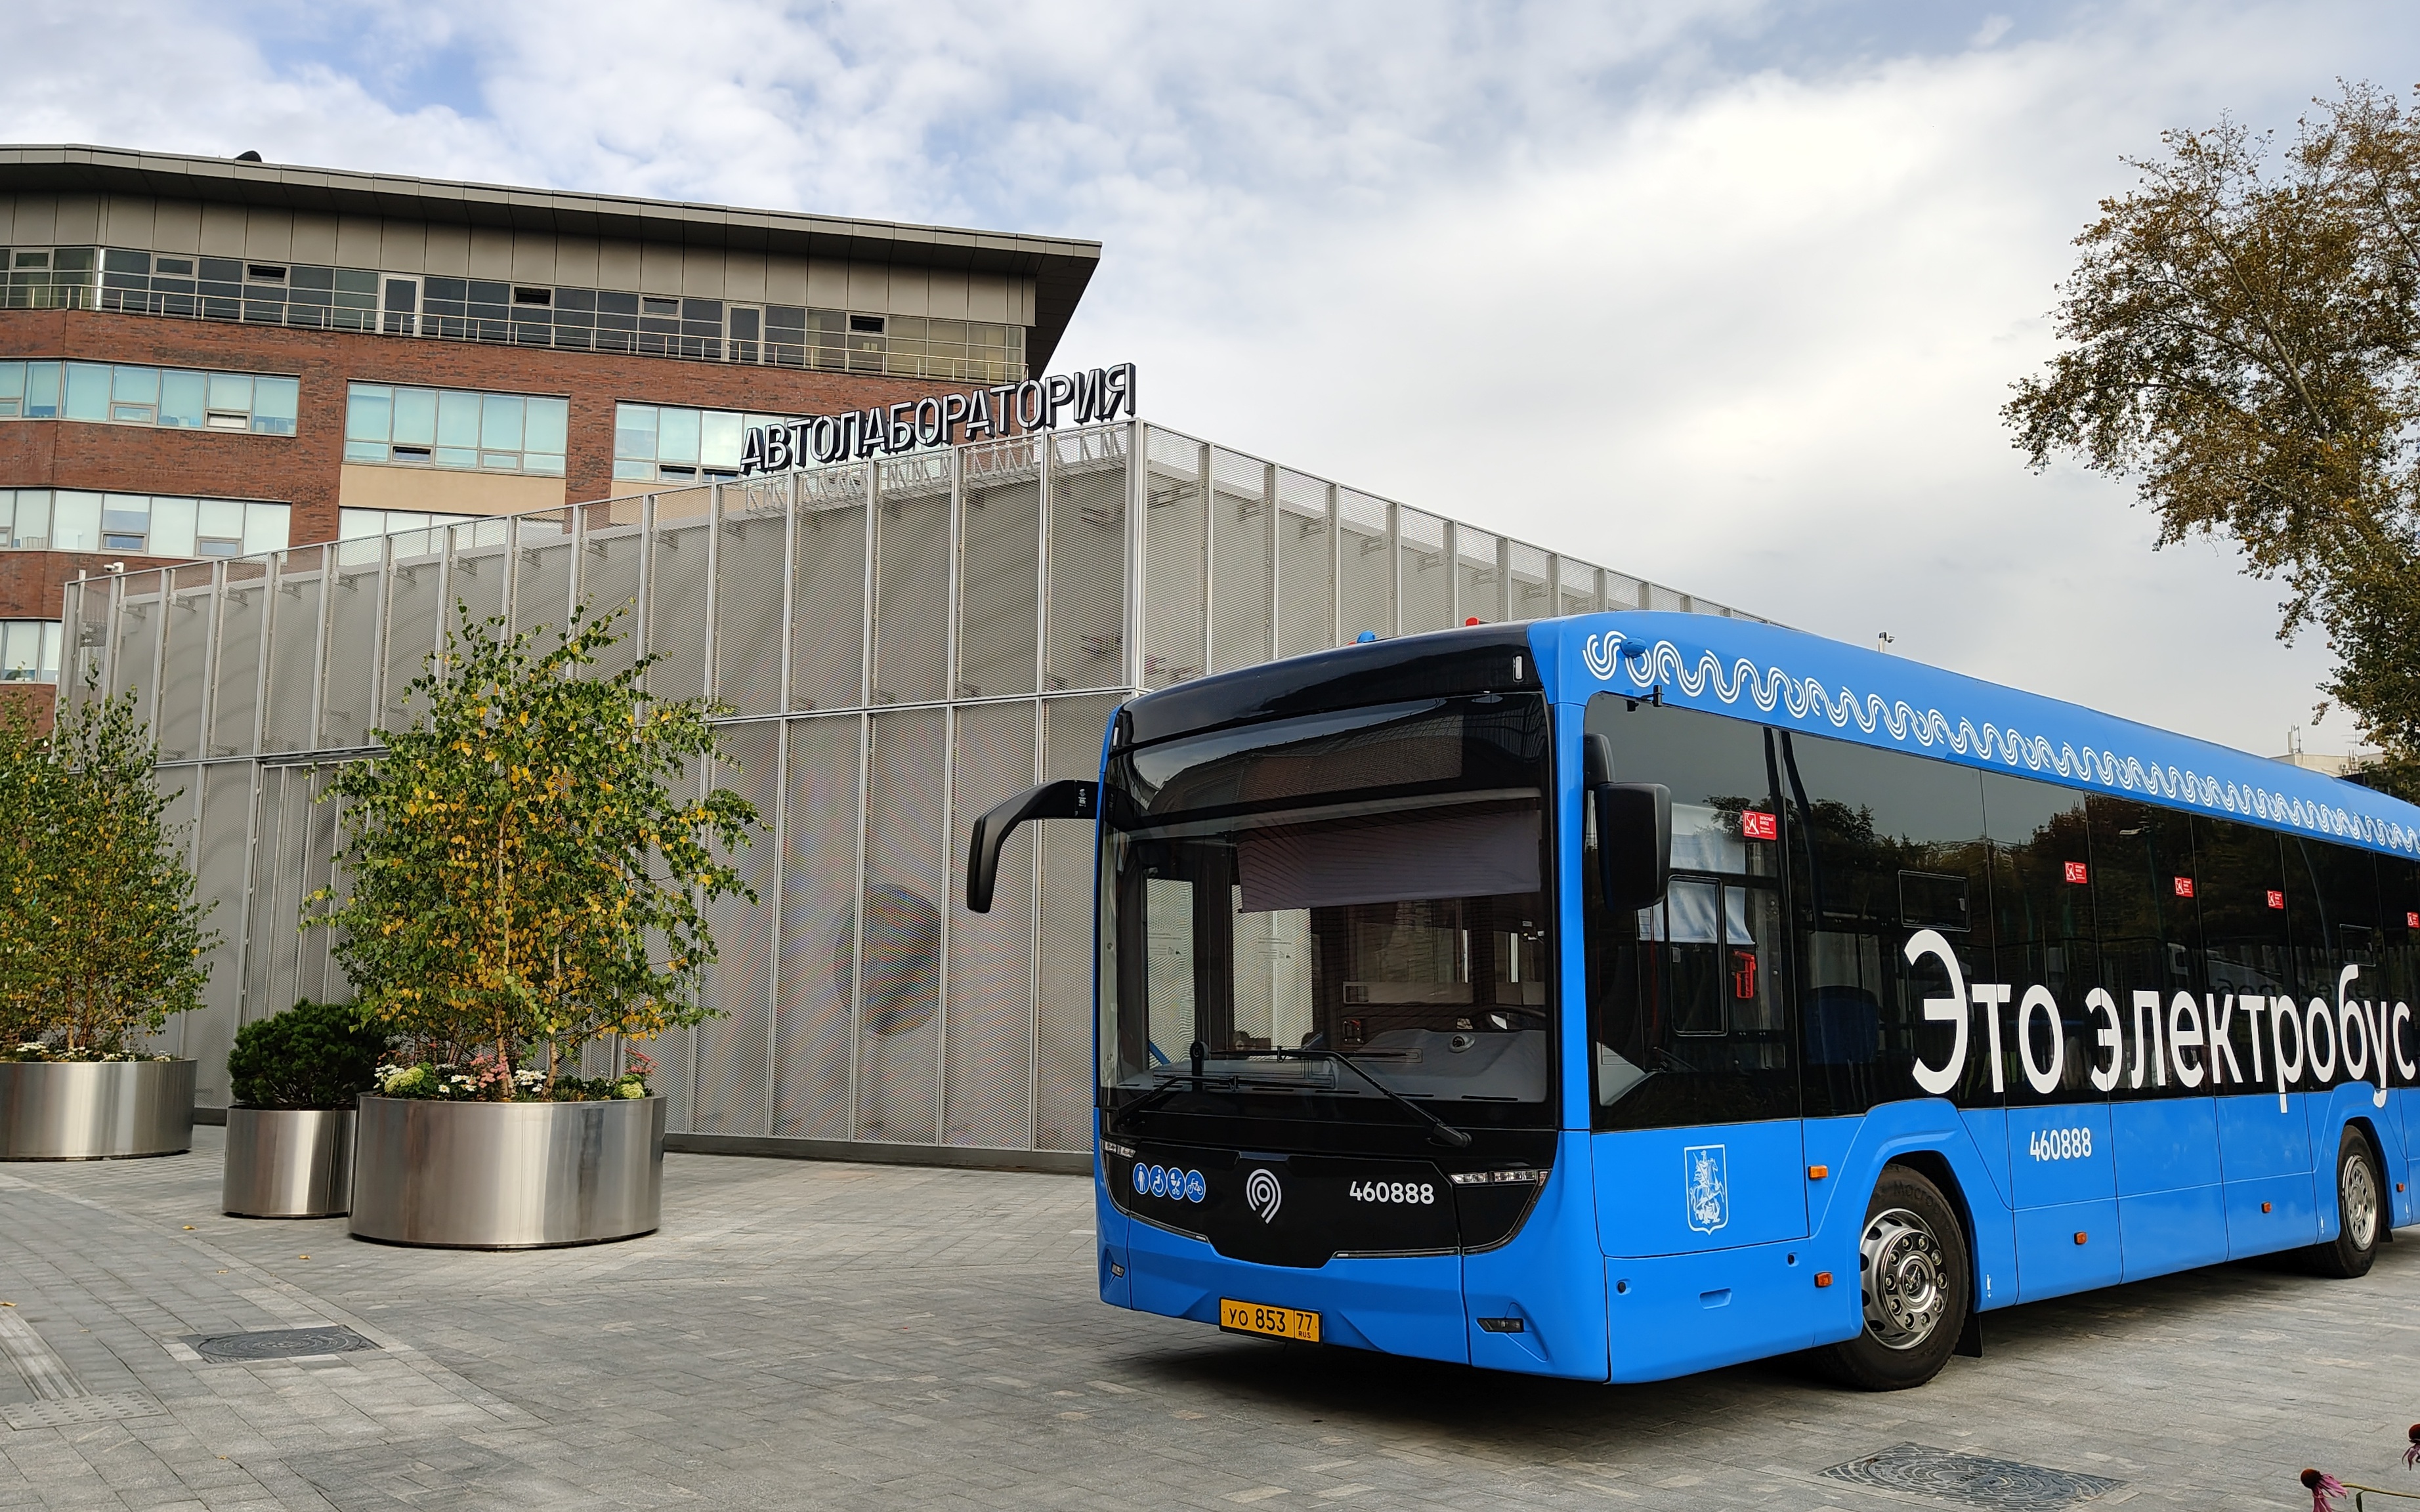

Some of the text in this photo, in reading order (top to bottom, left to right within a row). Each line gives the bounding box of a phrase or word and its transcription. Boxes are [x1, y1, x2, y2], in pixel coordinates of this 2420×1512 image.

[739, 362, 1136, 476] АВТОЛАБОРАТОРИЯ
[1904, 929, 2417, 1114] Это электробус
[2029, 1127, 2092, 1162] 460888
[1349, 1181, 1435, 1204] 460888
[1255, 1308, 1286, 1333] 853
[1296, 1312, 1313, 1331] 77
